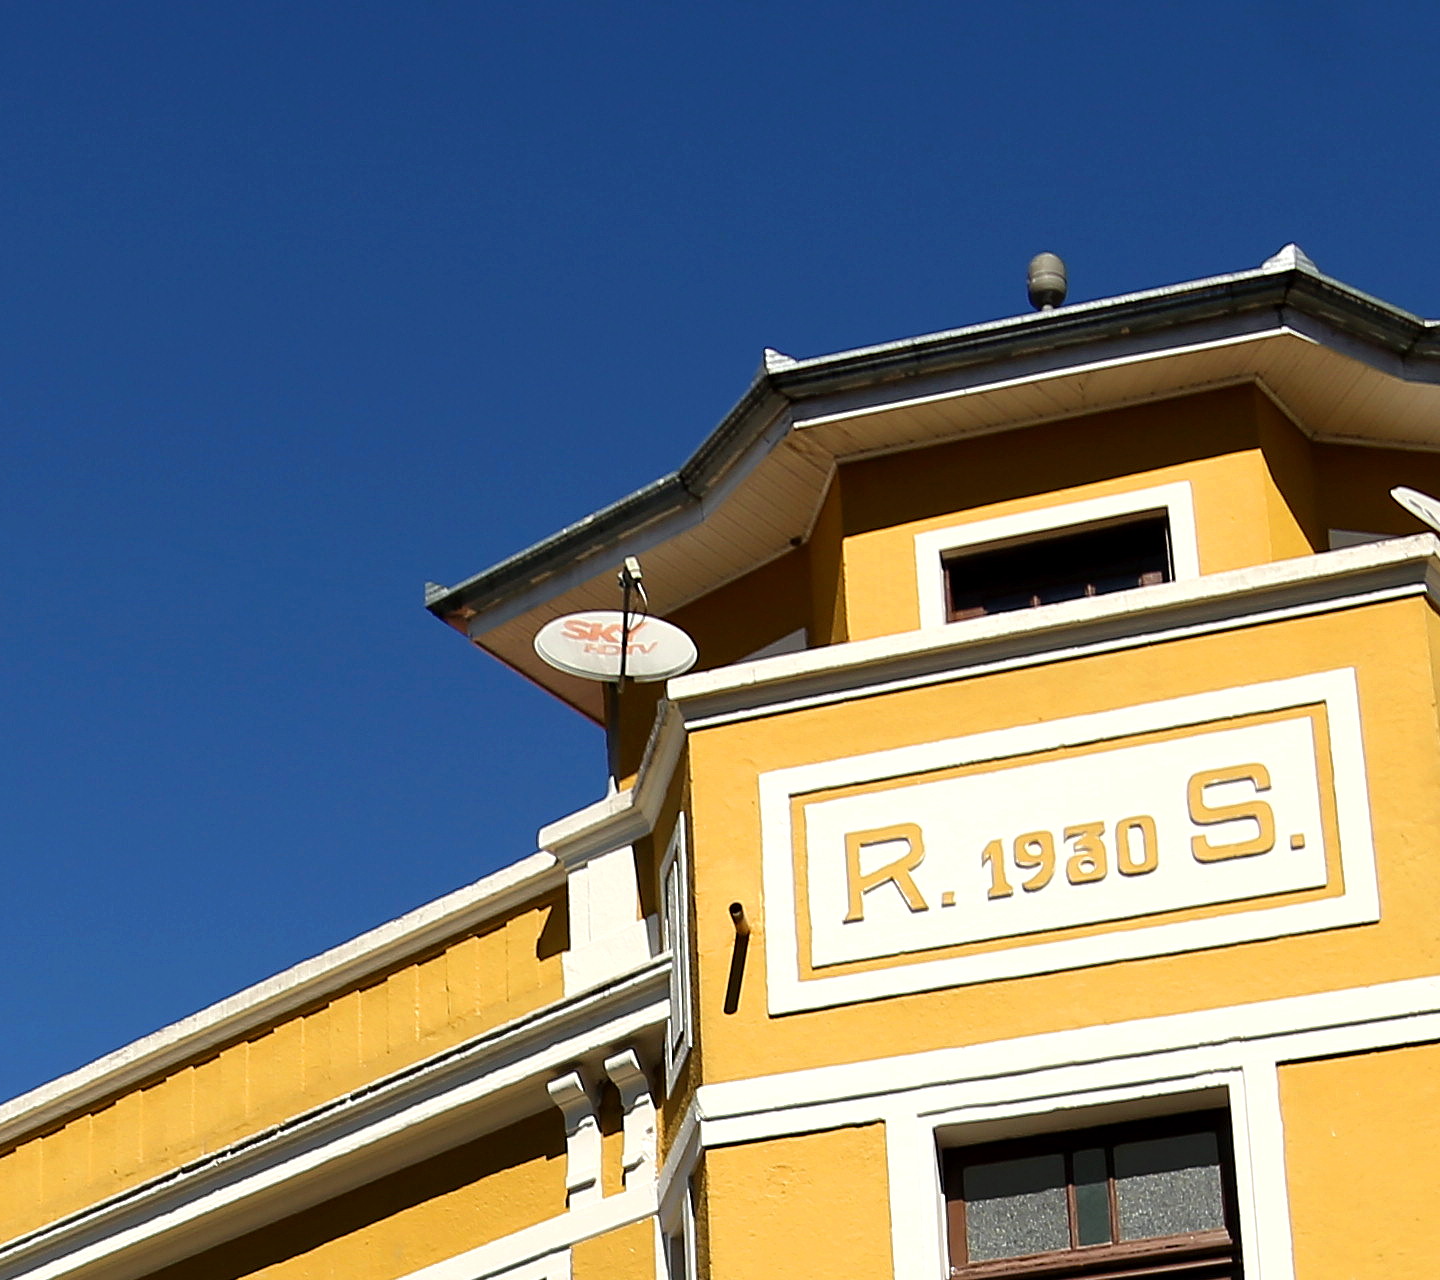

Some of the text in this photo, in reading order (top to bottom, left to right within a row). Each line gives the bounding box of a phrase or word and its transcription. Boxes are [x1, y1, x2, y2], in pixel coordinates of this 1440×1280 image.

[561, 620, 650, 643] SKY
[841, 762, 1307, 924] R. 1930 S.
